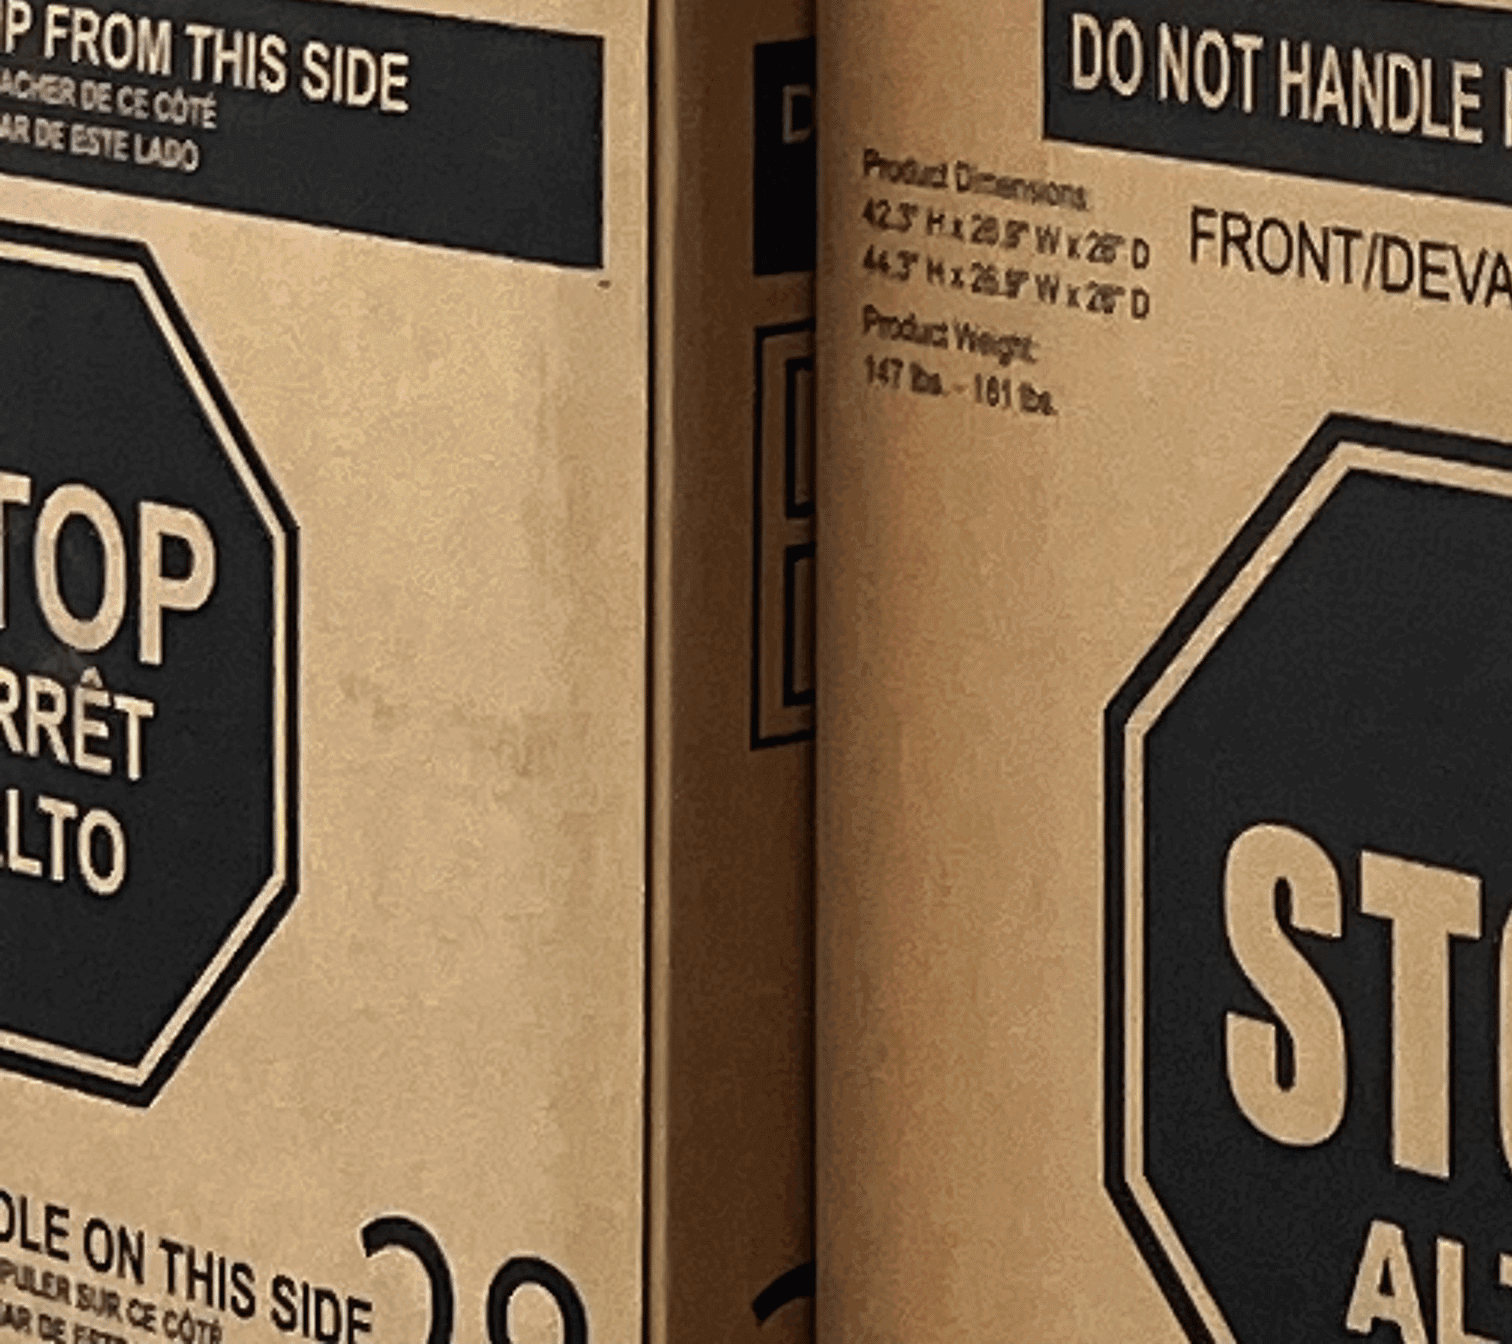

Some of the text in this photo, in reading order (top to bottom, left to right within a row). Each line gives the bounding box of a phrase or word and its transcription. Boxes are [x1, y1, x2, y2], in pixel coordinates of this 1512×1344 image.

[44, 3, 172, 77] FROM
[185, 23, 288, 94] THIS
[302, 40, 410, 113] SIDE
[80, 79, 113, 113] DE
[116, 85, 149, 119] CE
[1072, 13, 1144, 97] DO
[1158, 23, 1264, 114] NOT
[1279, 38, 1483, 144] HANDLE
[34, 117, 65, 151] DE
[70, 123, 130, 162] ESTE
[134, 133, 199, 172] LADO
[925, 206, 946, 236] H
[1035, 224, 1062, 255] W
[1131, 237, 1150, 270] D
[925, 255, 946, 286] H
[1035, 273, 1061, 306] W
[1131, 287, 1150, 320] D
[0, 788, 127, 896] LTO
[83, 1217, 146, 1286] ON
[159, 1237, 256, 1319] THIS
